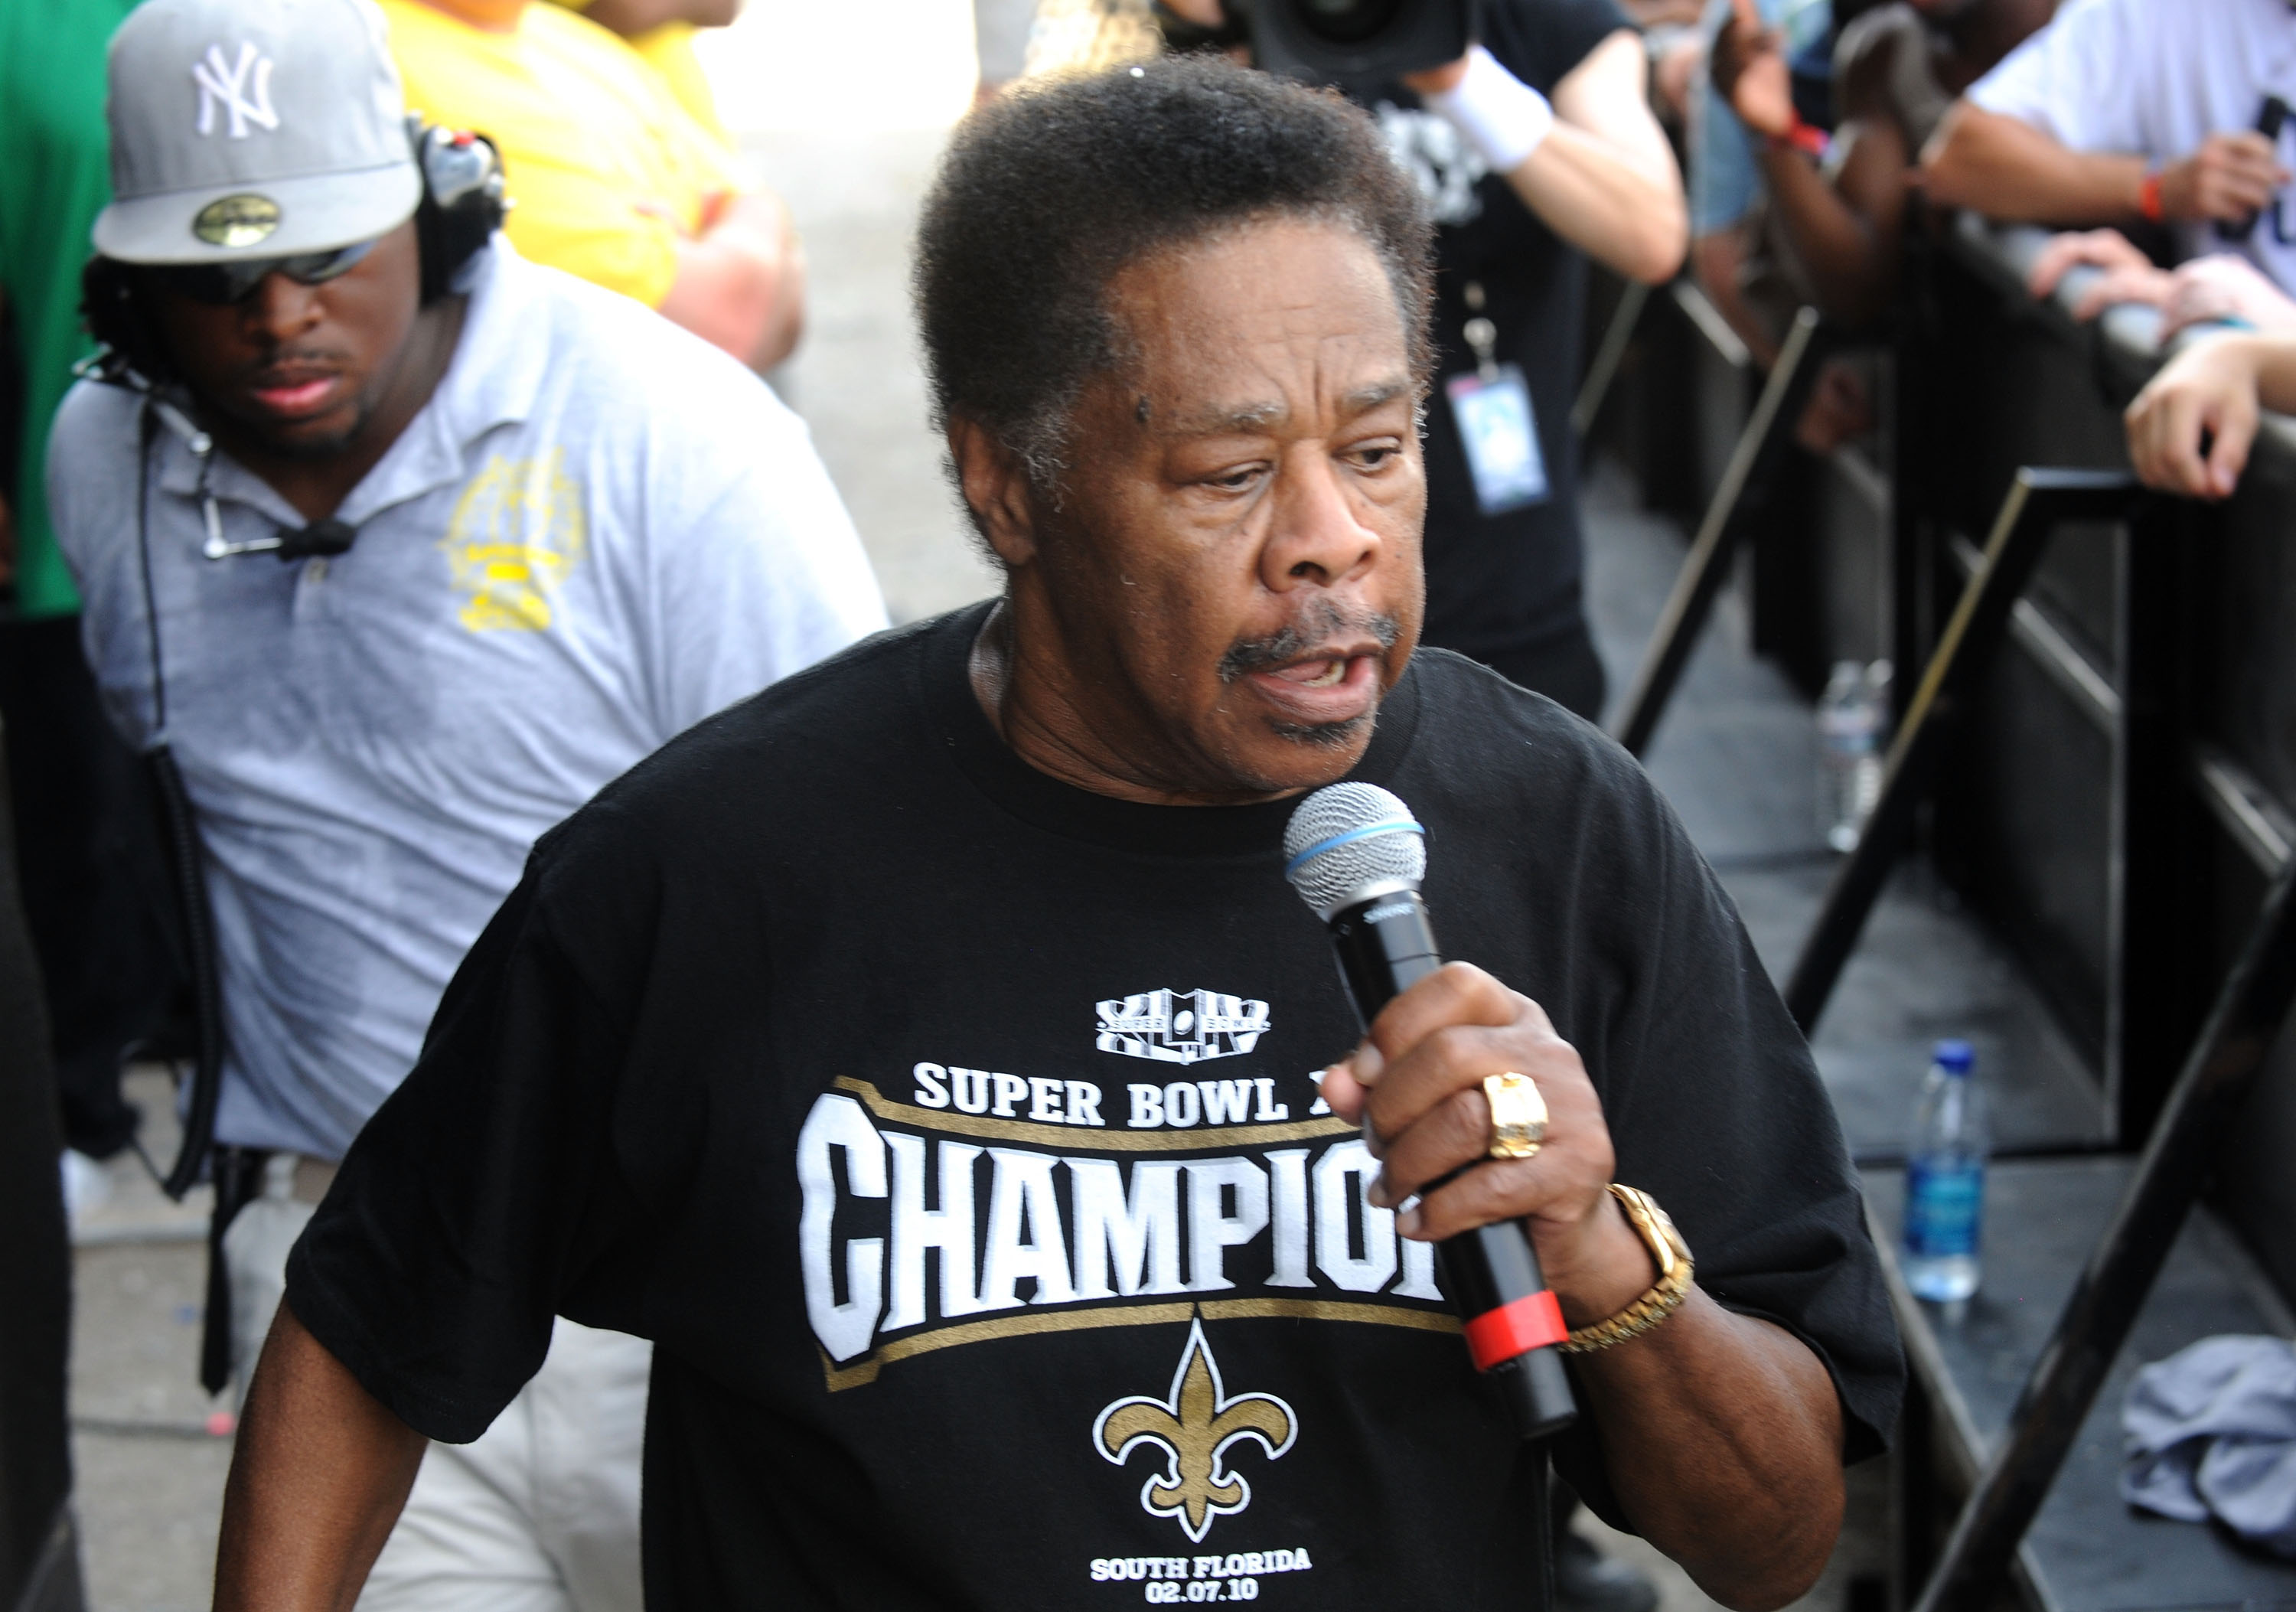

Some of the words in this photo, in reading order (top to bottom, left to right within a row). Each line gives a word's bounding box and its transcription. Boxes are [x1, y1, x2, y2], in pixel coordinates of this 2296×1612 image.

[194, 41, 280, 139] NY
[912, 1060, 1106, 1127] SUPER
[1127, 1078, 1290, 1128] BOWL
[1090, 1557, 1189, 1581] SOUTH
[1192, 1547, 1313, 1578] FLORIDA
[1144, 1577, 1260, 1604] 02.07.10
